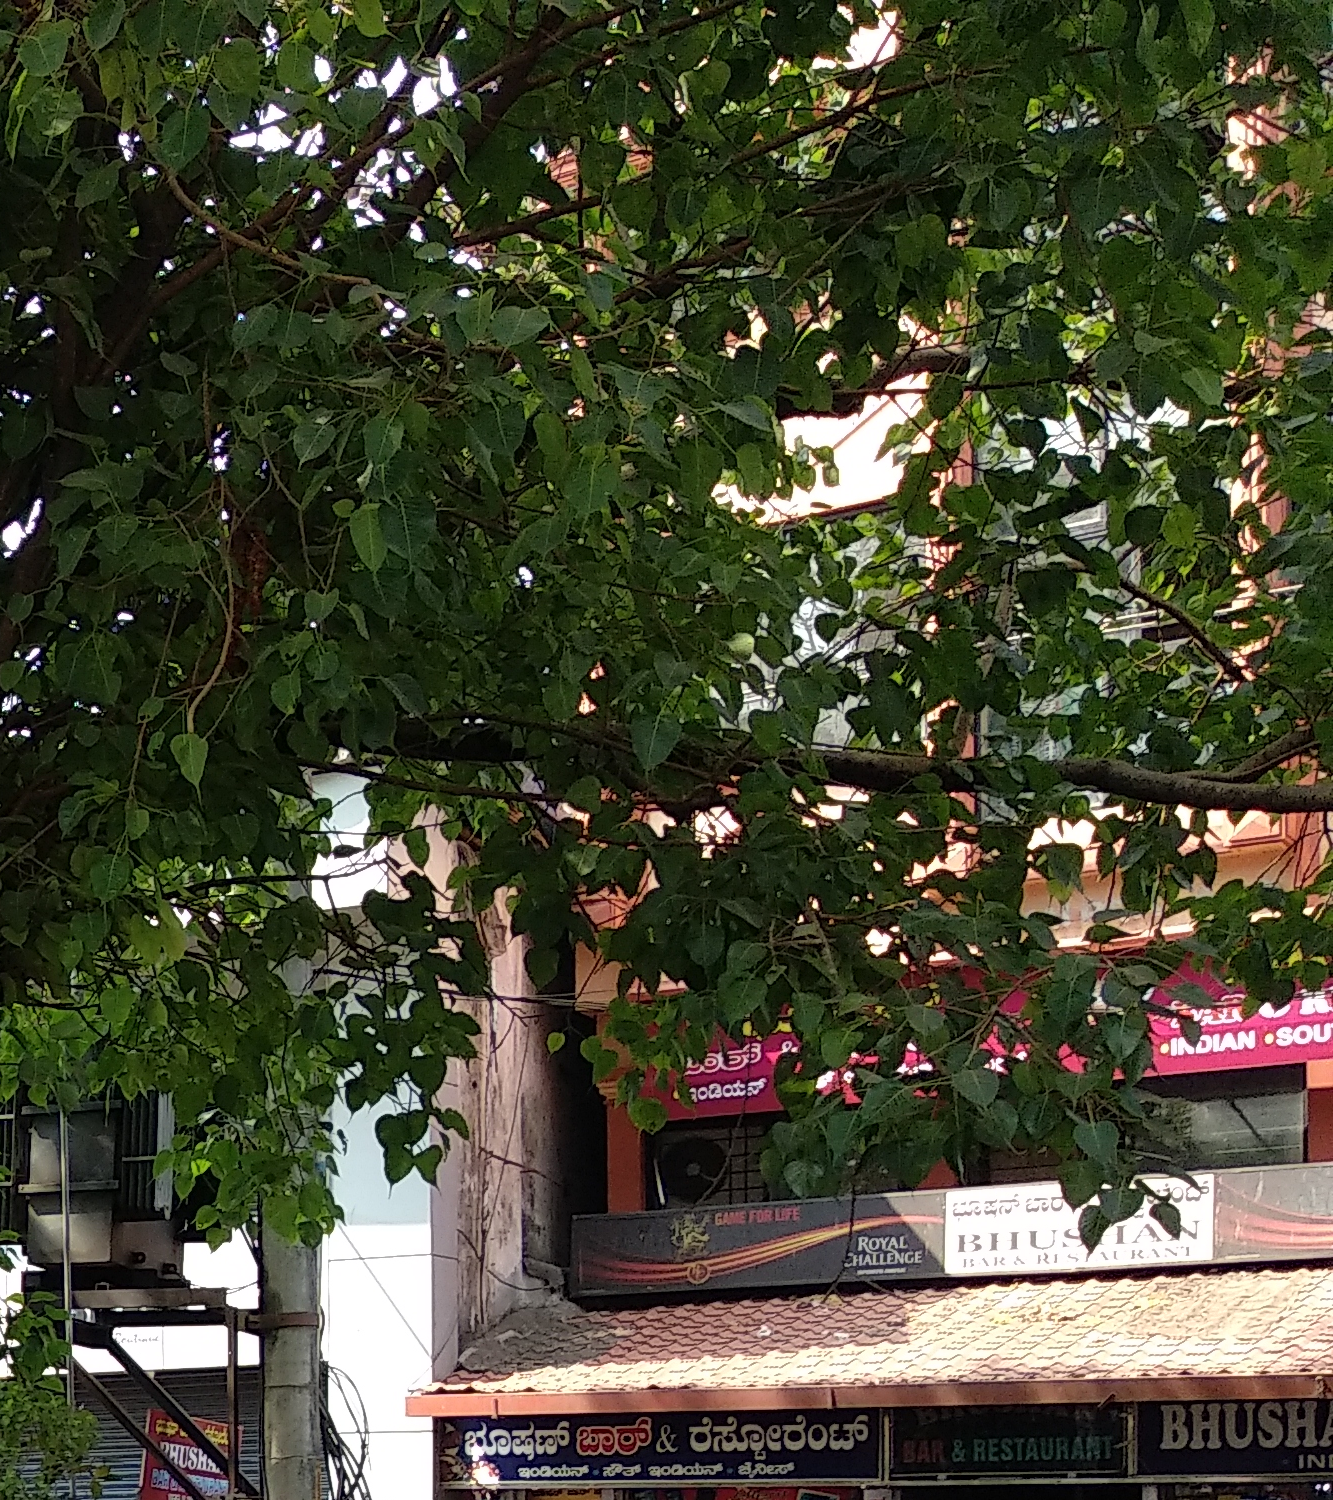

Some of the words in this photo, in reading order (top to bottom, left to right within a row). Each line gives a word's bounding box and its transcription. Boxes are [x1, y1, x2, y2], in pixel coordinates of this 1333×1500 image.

[1170, 1029, 1256, 1057] INDIAN
[1275, 1022, 1333, 1047] SOU
[715, 1210, 746, 1226] GAME
[749, 1208, 773, 1223] FOR
[775, 1206, 800, 1221] LIFE
[857, 1235, 909, 1253] ROYAL
[844, 1250, 923, 1268] CHALLENGE
[962, 1256, 1005, 1269] BAR
[1013, 1255, 1026, 1266] &
[576, 1417, 653, 1456] ಬಾರ್
[655, 1428, 679, 1454] &
[902, 1438, 945, 1463] BAR
[950, 1437, 967, 1463] &
[972, 1434, 1113, 1463] RESTAURANT
